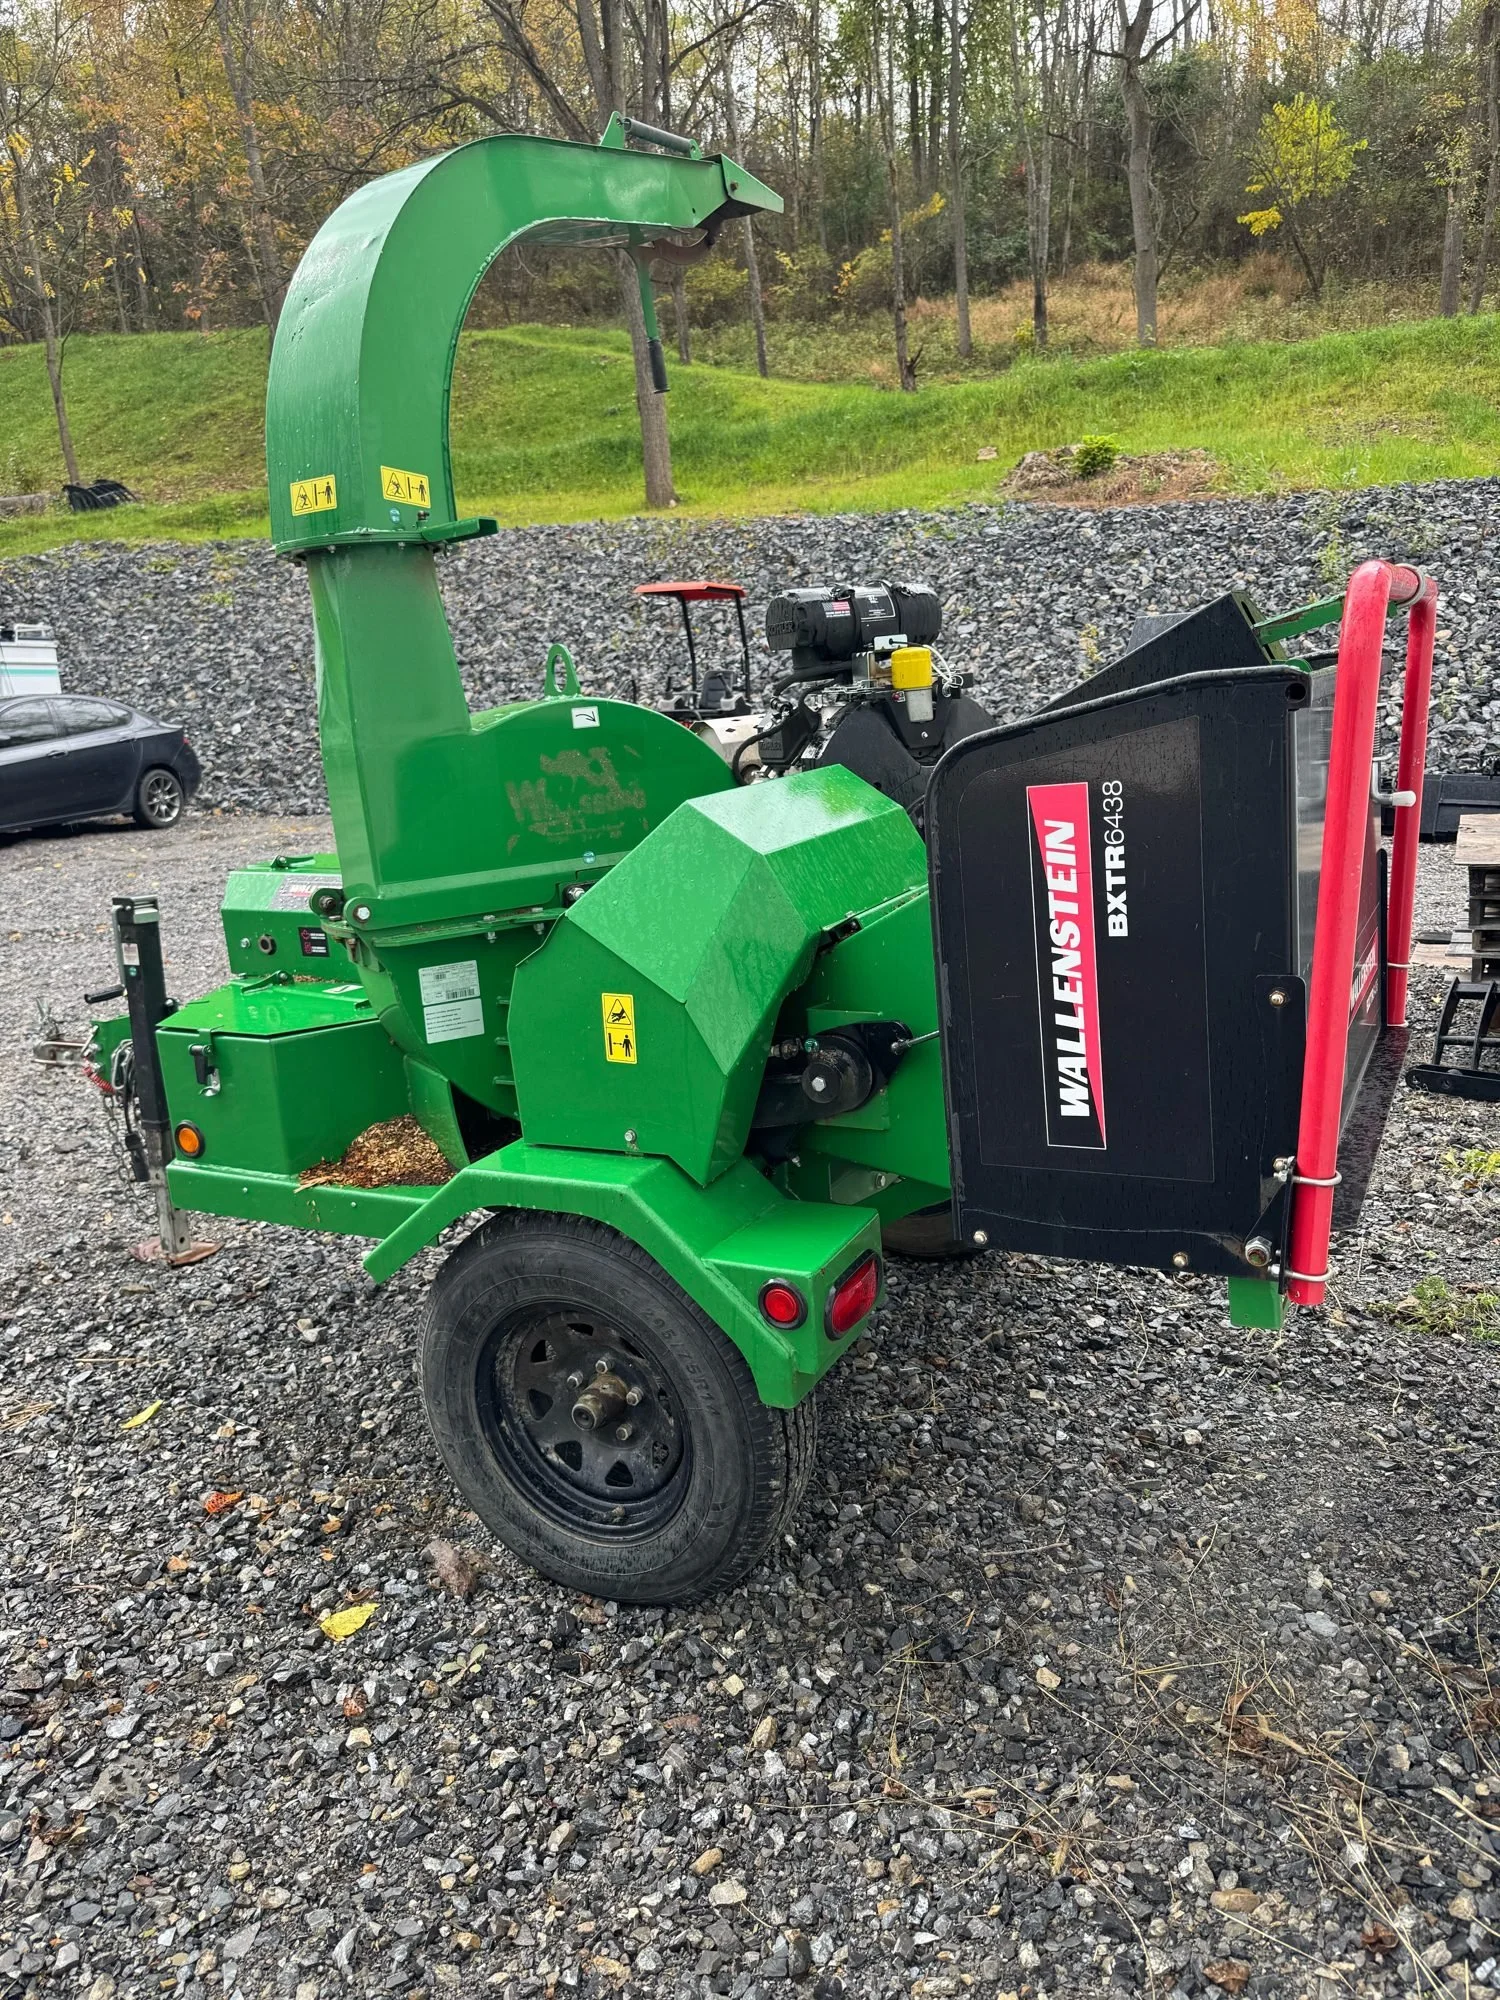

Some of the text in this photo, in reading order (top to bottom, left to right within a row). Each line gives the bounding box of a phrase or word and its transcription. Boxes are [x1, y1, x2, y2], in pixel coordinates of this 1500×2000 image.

[767, 621, 796, 635] KOHLER
[1102, 780, 1129, 937] BXTR6438
[1043, 819, 1090, 1117] WALLENSTEIN
